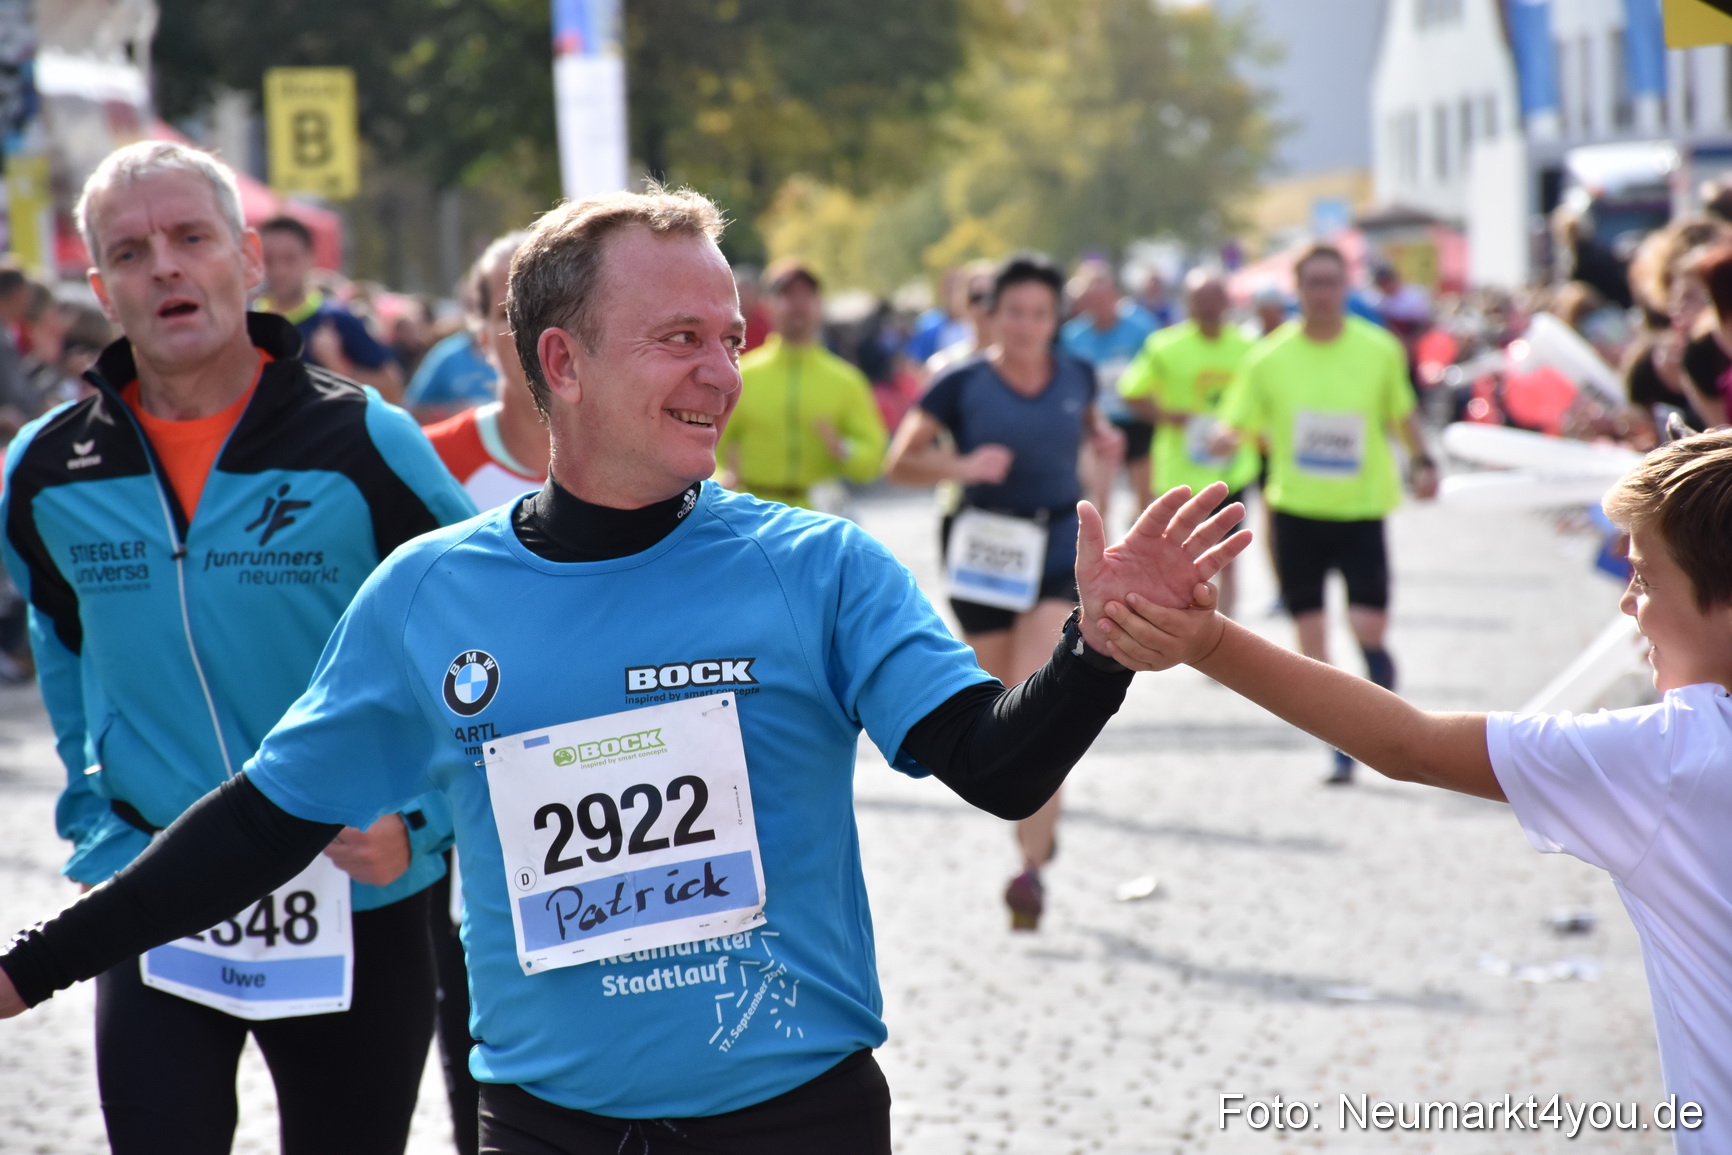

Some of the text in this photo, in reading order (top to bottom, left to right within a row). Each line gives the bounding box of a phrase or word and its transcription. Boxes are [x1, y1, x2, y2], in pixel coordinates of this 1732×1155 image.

[291, 109, 333, 168] B
[70, 541, 146, 564] STIEGLER
[204, 549, 324, 572] funrunners
[238, 566, 339, 585] neumarkt
[450, 652, 495, 676] BMW
[626, 659, 757, 693] BOCK
[625, 693, 666, 705] inspired
[669, 691, 680, 701] by
[685, 688, 713, 699] smart
[452, 723, 501, 743] ARTL
[577, 728, 665, 763] BOCK
[581, 747, 668, 769] inspired by smart concepts
[534, 775, 716, 875] 2922
[546, 861, 731, 940] Patrick
[221, 966, 266, 988] Uwe
[602, 956, 729, 996] Stadtlauf
[719, 962, 787, 1053] 17. September 2017
